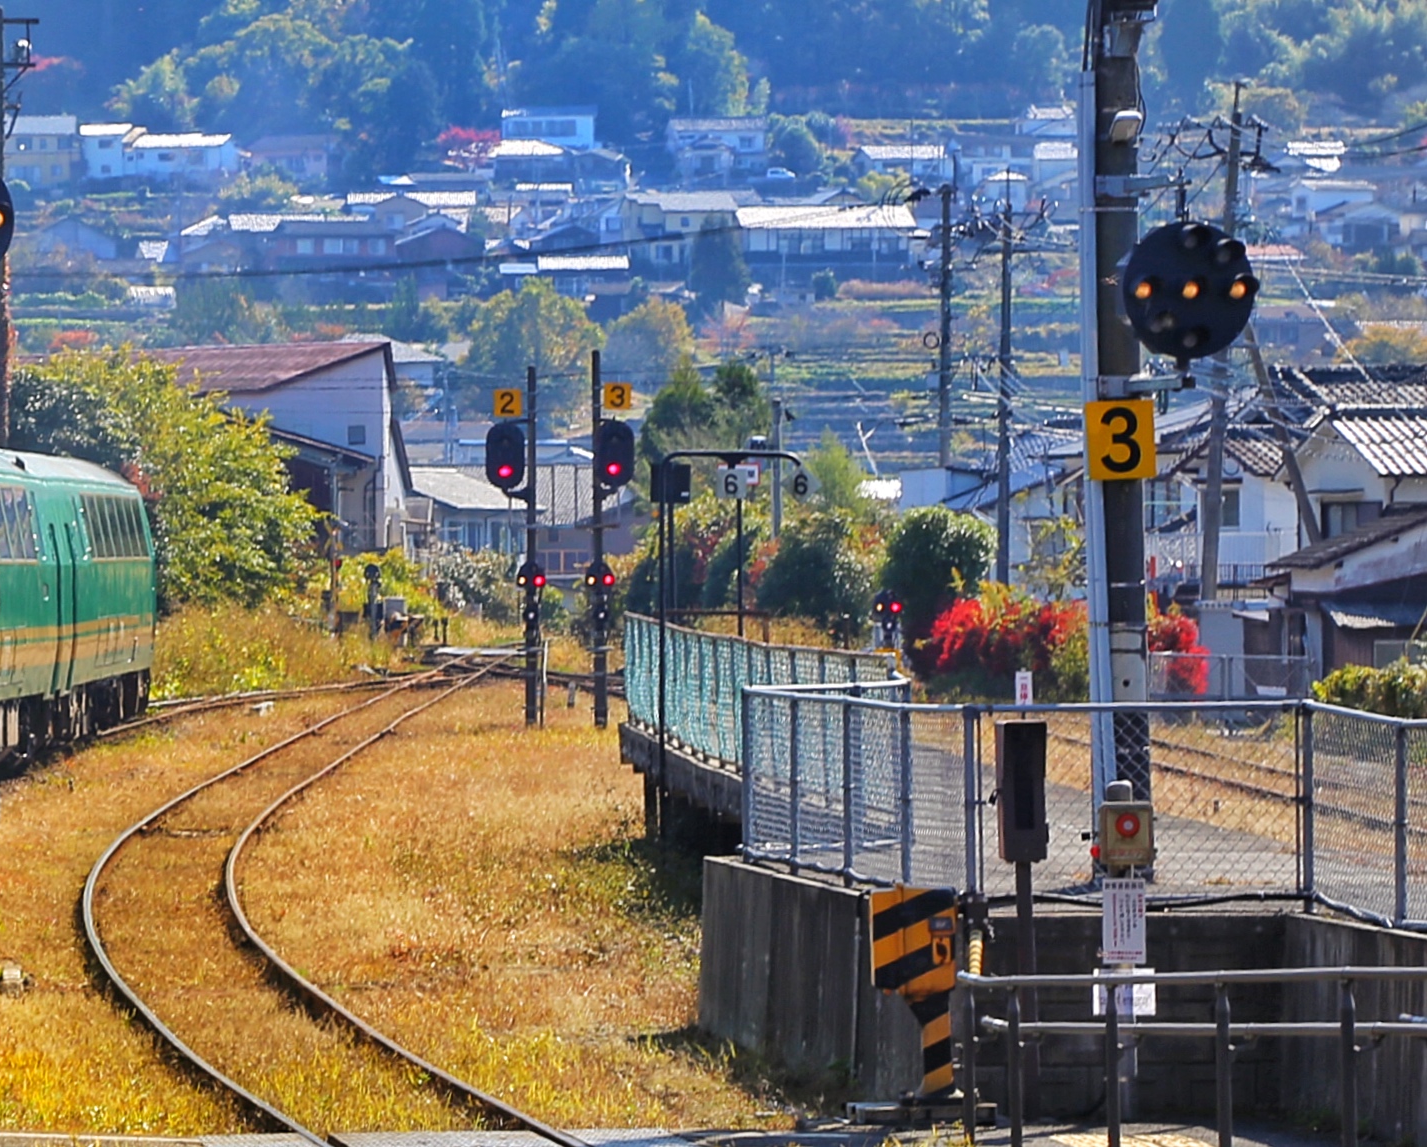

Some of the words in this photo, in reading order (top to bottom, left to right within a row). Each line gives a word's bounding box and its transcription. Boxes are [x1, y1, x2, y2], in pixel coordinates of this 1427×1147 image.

[499, 391, 515, 414] 2
[610, 386, 625, 408] 3
[1100, 407, 1141, 473] 3
[724, 473, 738, 495] 6
[793, 473, 808, 495] 6
